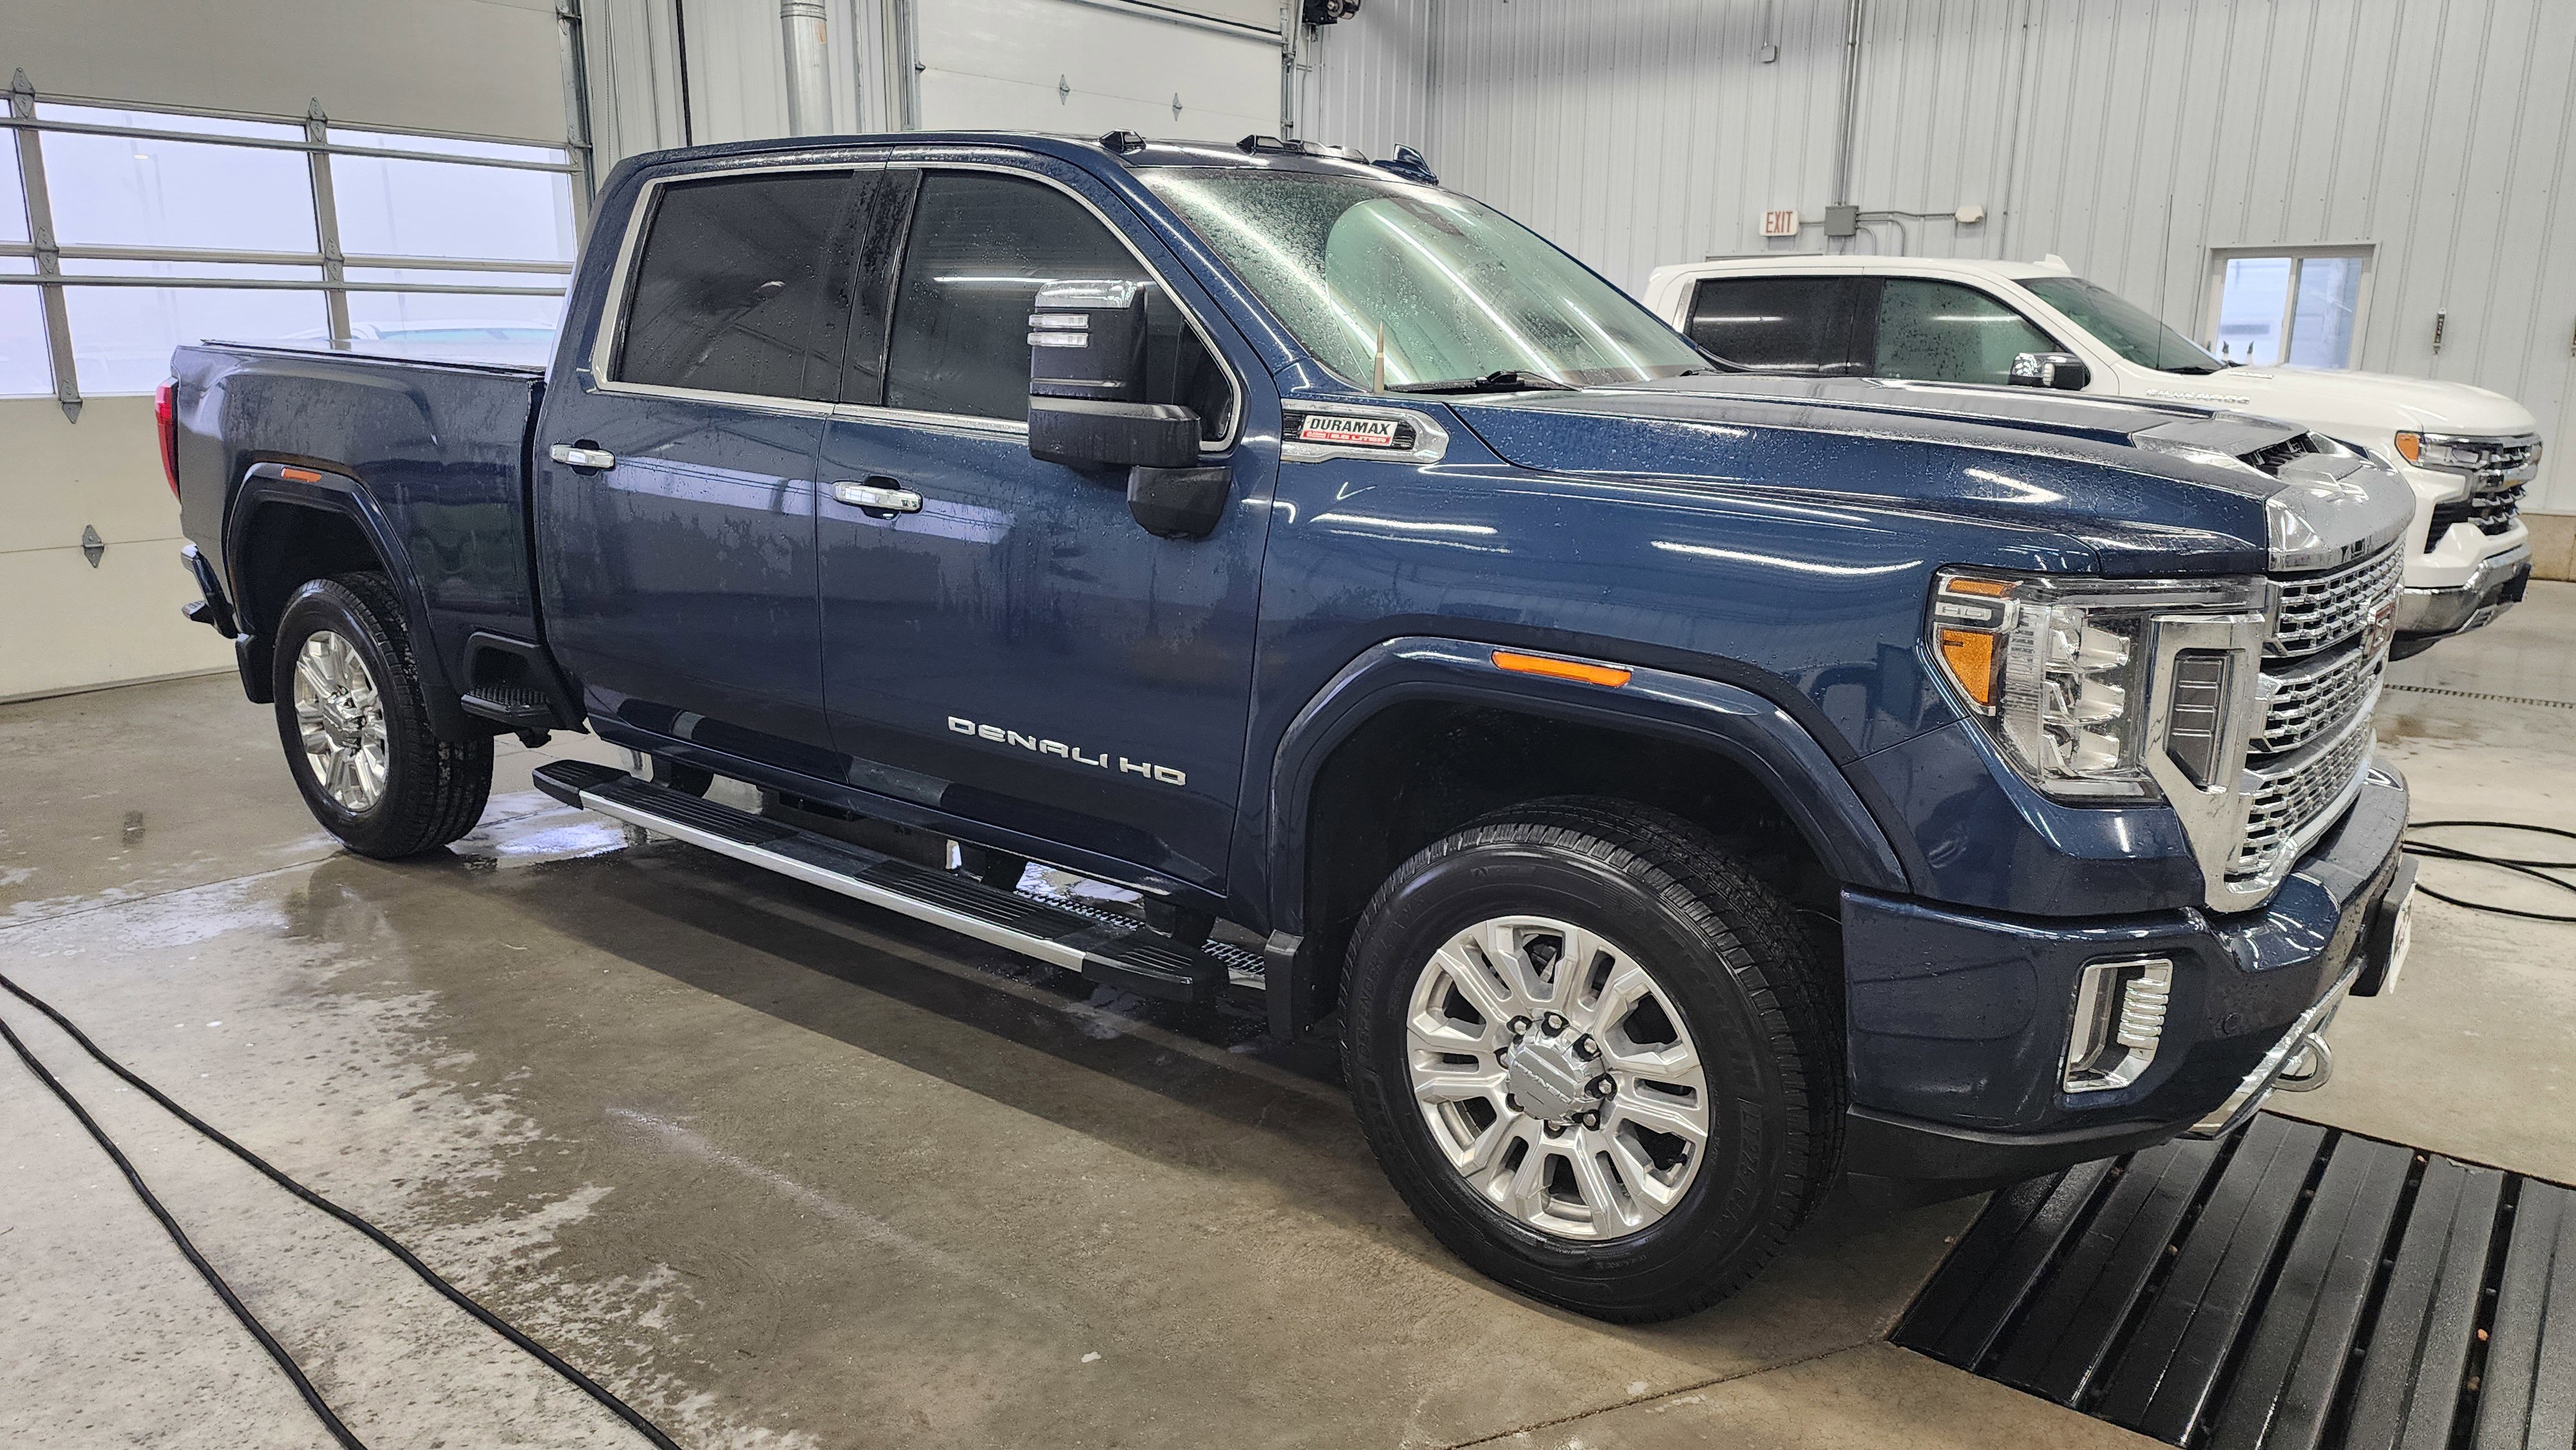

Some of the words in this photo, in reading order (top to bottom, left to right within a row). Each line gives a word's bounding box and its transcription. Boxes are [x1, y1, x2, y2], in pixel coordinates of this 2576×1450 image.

[1766, 211, 1794, 233] EXIT
[1309, 417, 1392, 435] DURAMAX
[947, 716, 1108, 769] DENALI
[1119, 757, 1186, 786] HD
